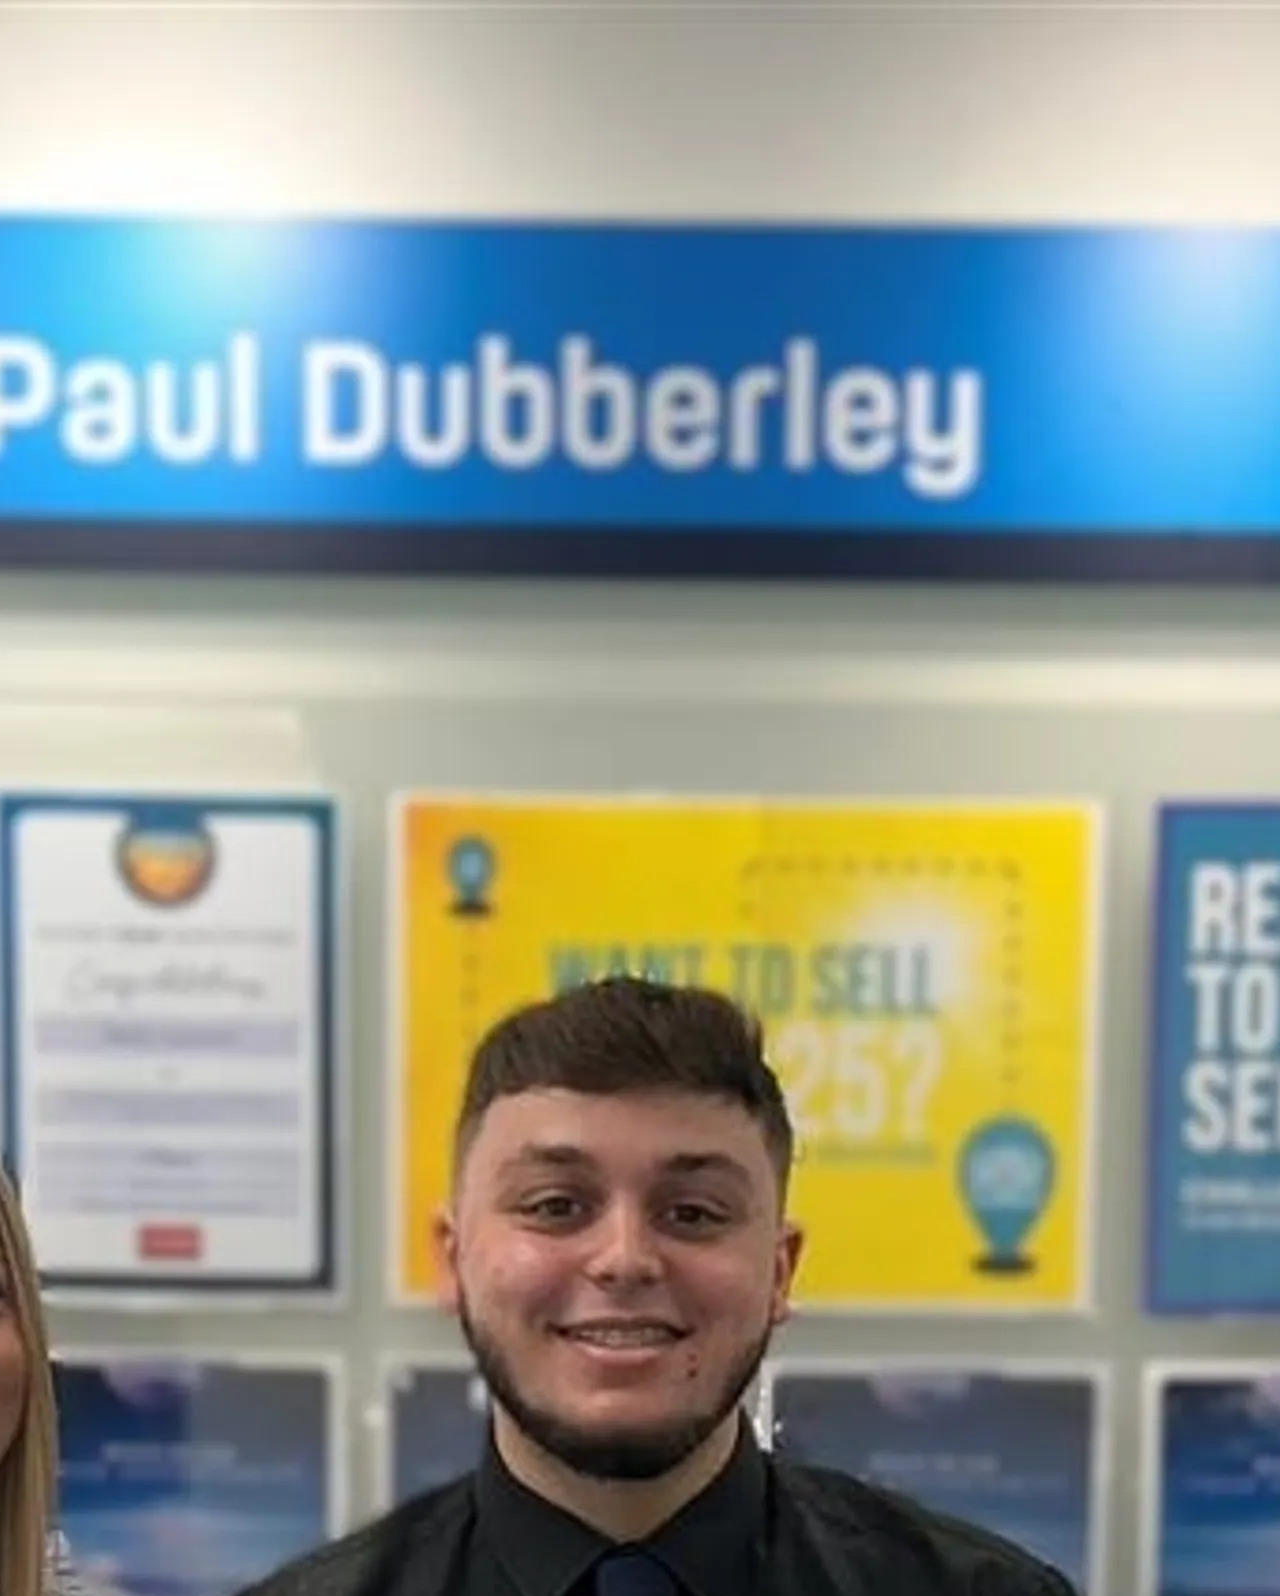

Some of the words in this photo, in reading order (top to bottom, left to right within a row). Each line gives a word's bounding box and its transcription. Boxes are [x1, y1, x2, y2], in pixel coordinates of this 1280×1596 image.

[302, 331, 982, 498] Dubberley
[731, 943, 796, 1017] TO
[811, 944, 939, 1018] SELL
